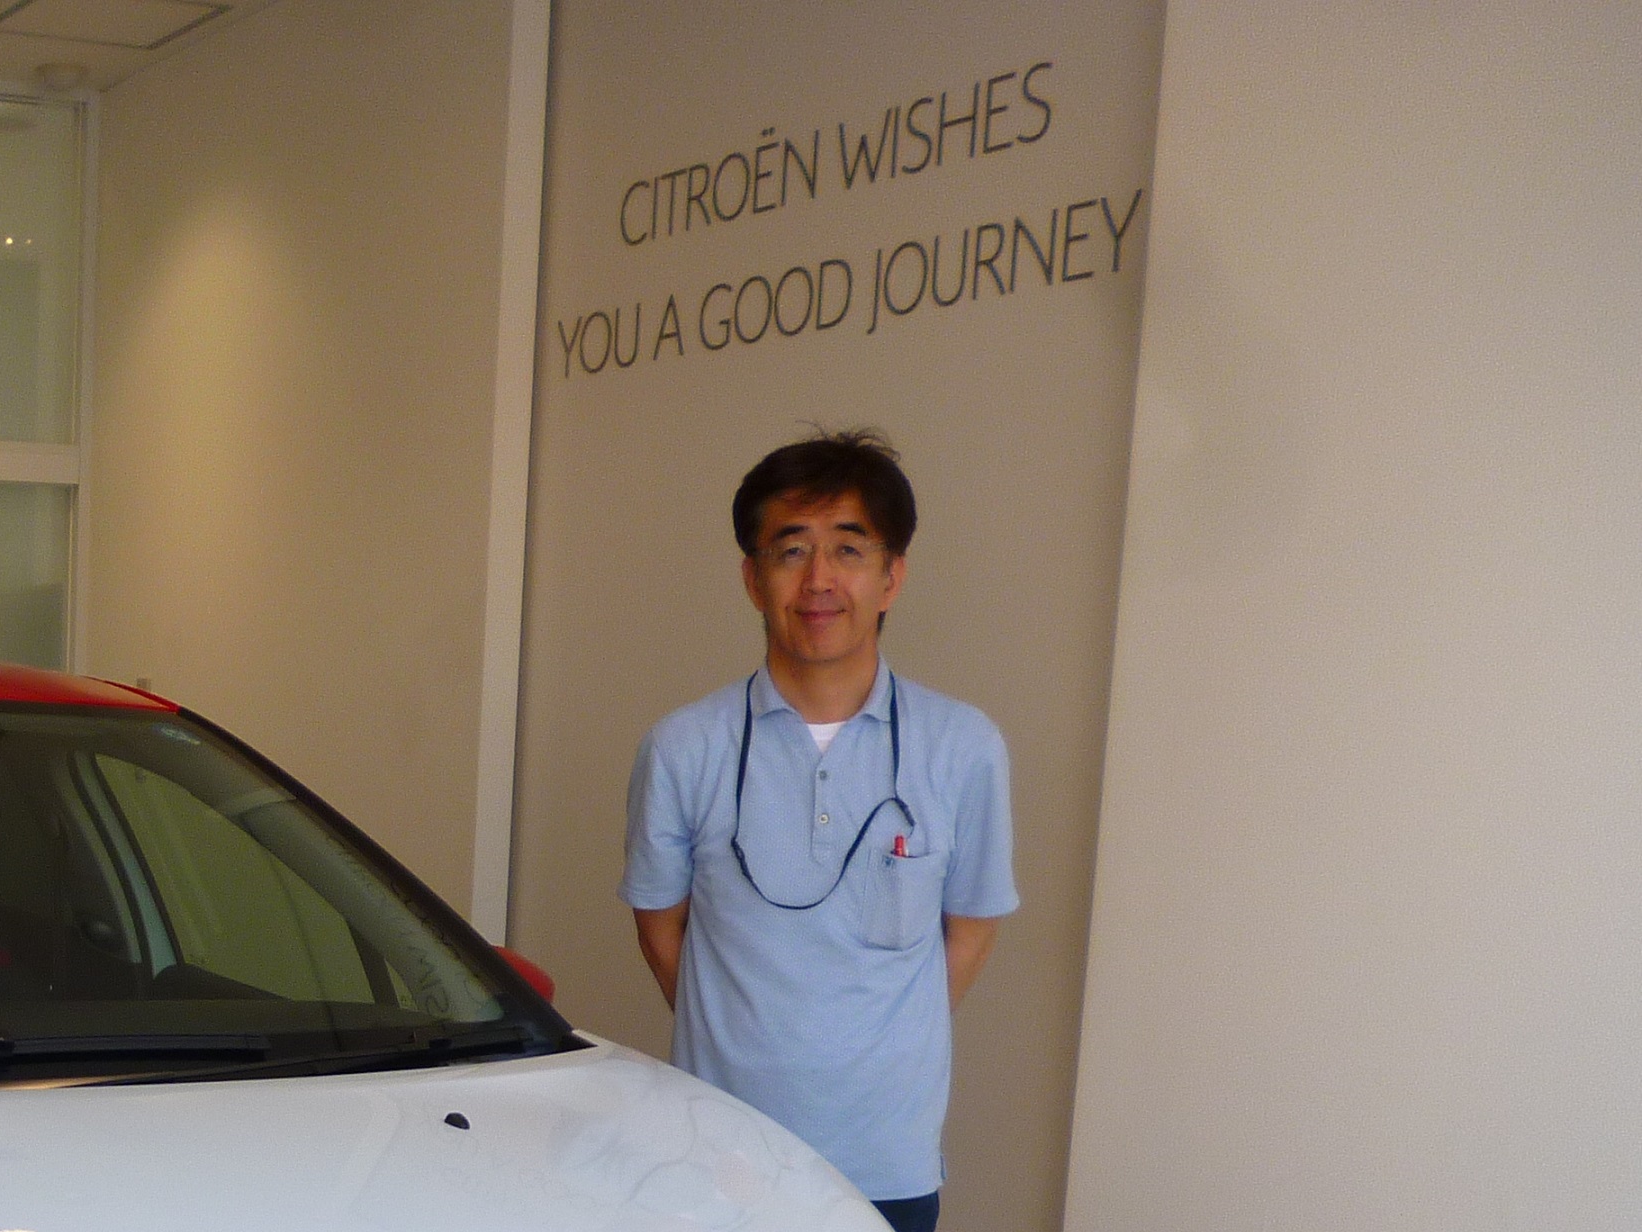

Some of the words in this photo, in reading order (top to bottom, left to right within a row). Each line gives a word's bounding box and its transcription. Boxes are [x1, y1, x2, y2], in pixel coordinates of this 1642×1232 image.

[619, 126, 820, 247] CITROËN
[838, 61, 1054, 191] WISHES
[557, 301, 642, 379] YOU
[652, 293, 685, 361] A
[698, 258, 853, 352] GOOD
[865, 188, 1143, 335] JOURNEY
